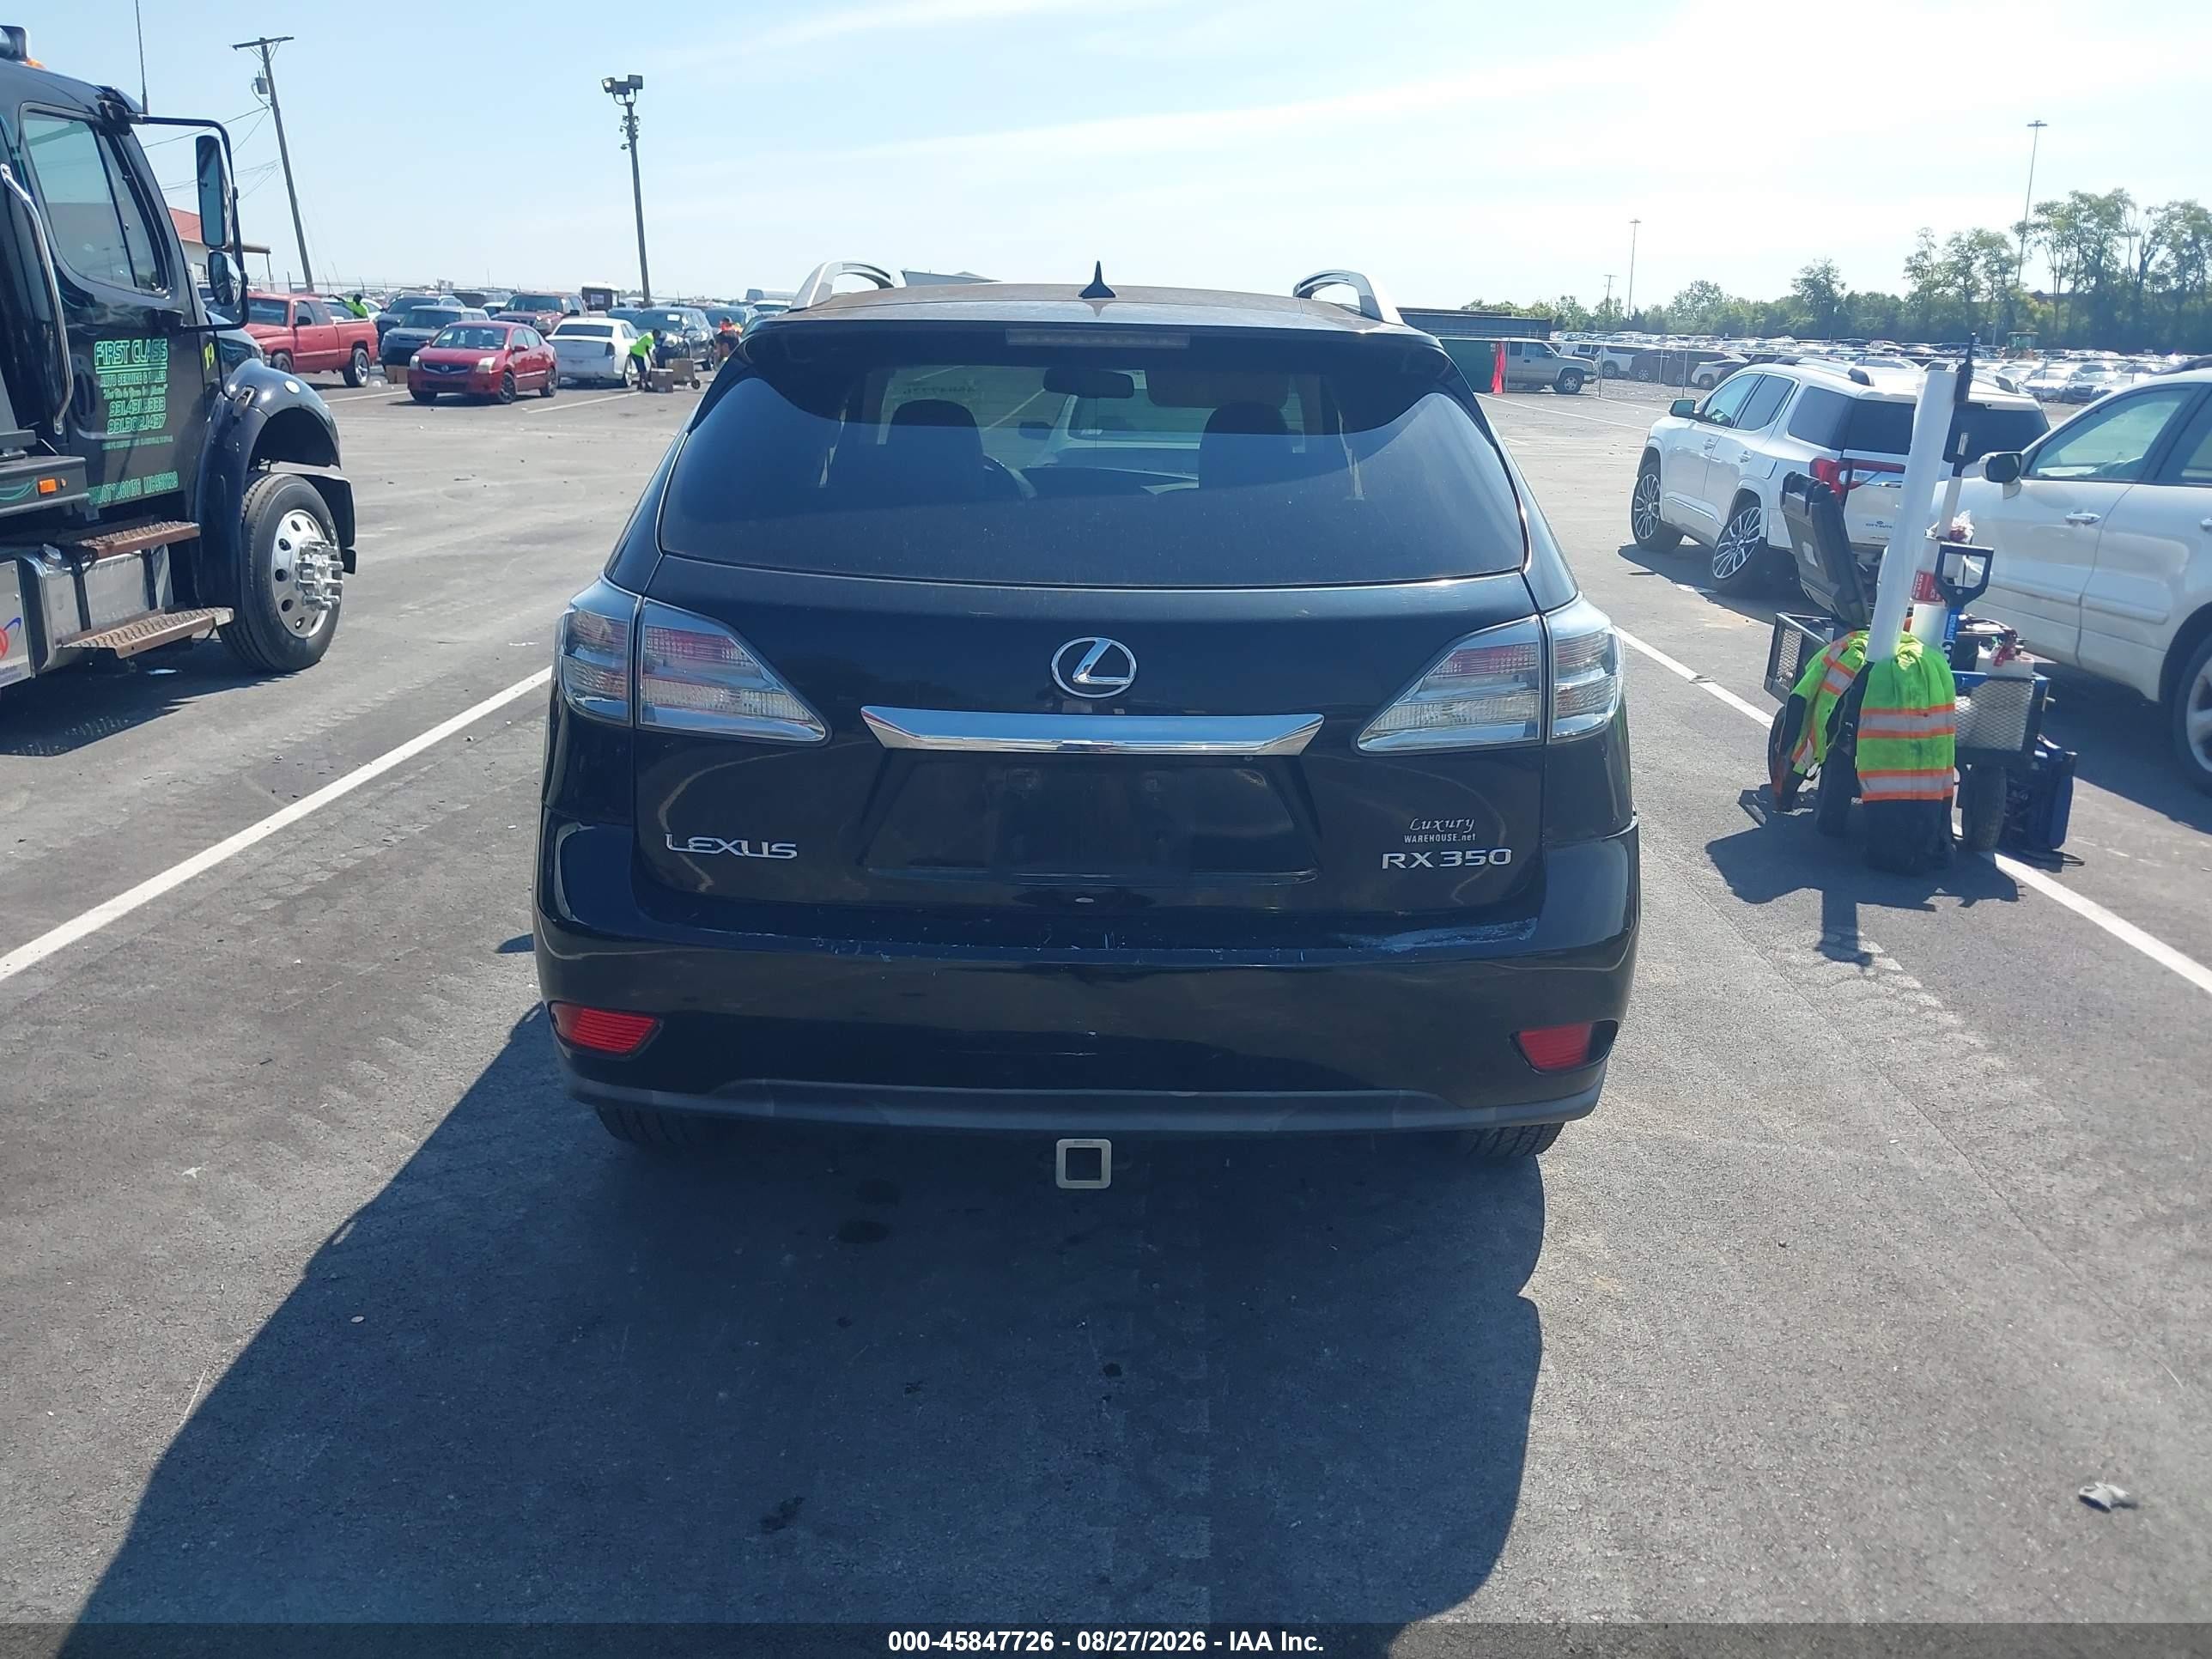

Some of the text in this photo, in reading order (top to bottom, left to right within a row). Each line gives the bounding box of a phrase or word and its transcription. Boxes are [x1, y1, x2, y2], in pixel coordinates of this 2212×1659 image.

[131, 338, 168, 363] CLASS
[204, 342, 215, 371] 19
[100, 374, 117, 388] AUTO
[118, 372, 143, 386] SERVICE
[1409, 817, 1474, 834] Luxury
[665, 833, 798, 860] LEXUS
[1404, 833, 1476, 843] WAREHOUSE.net
